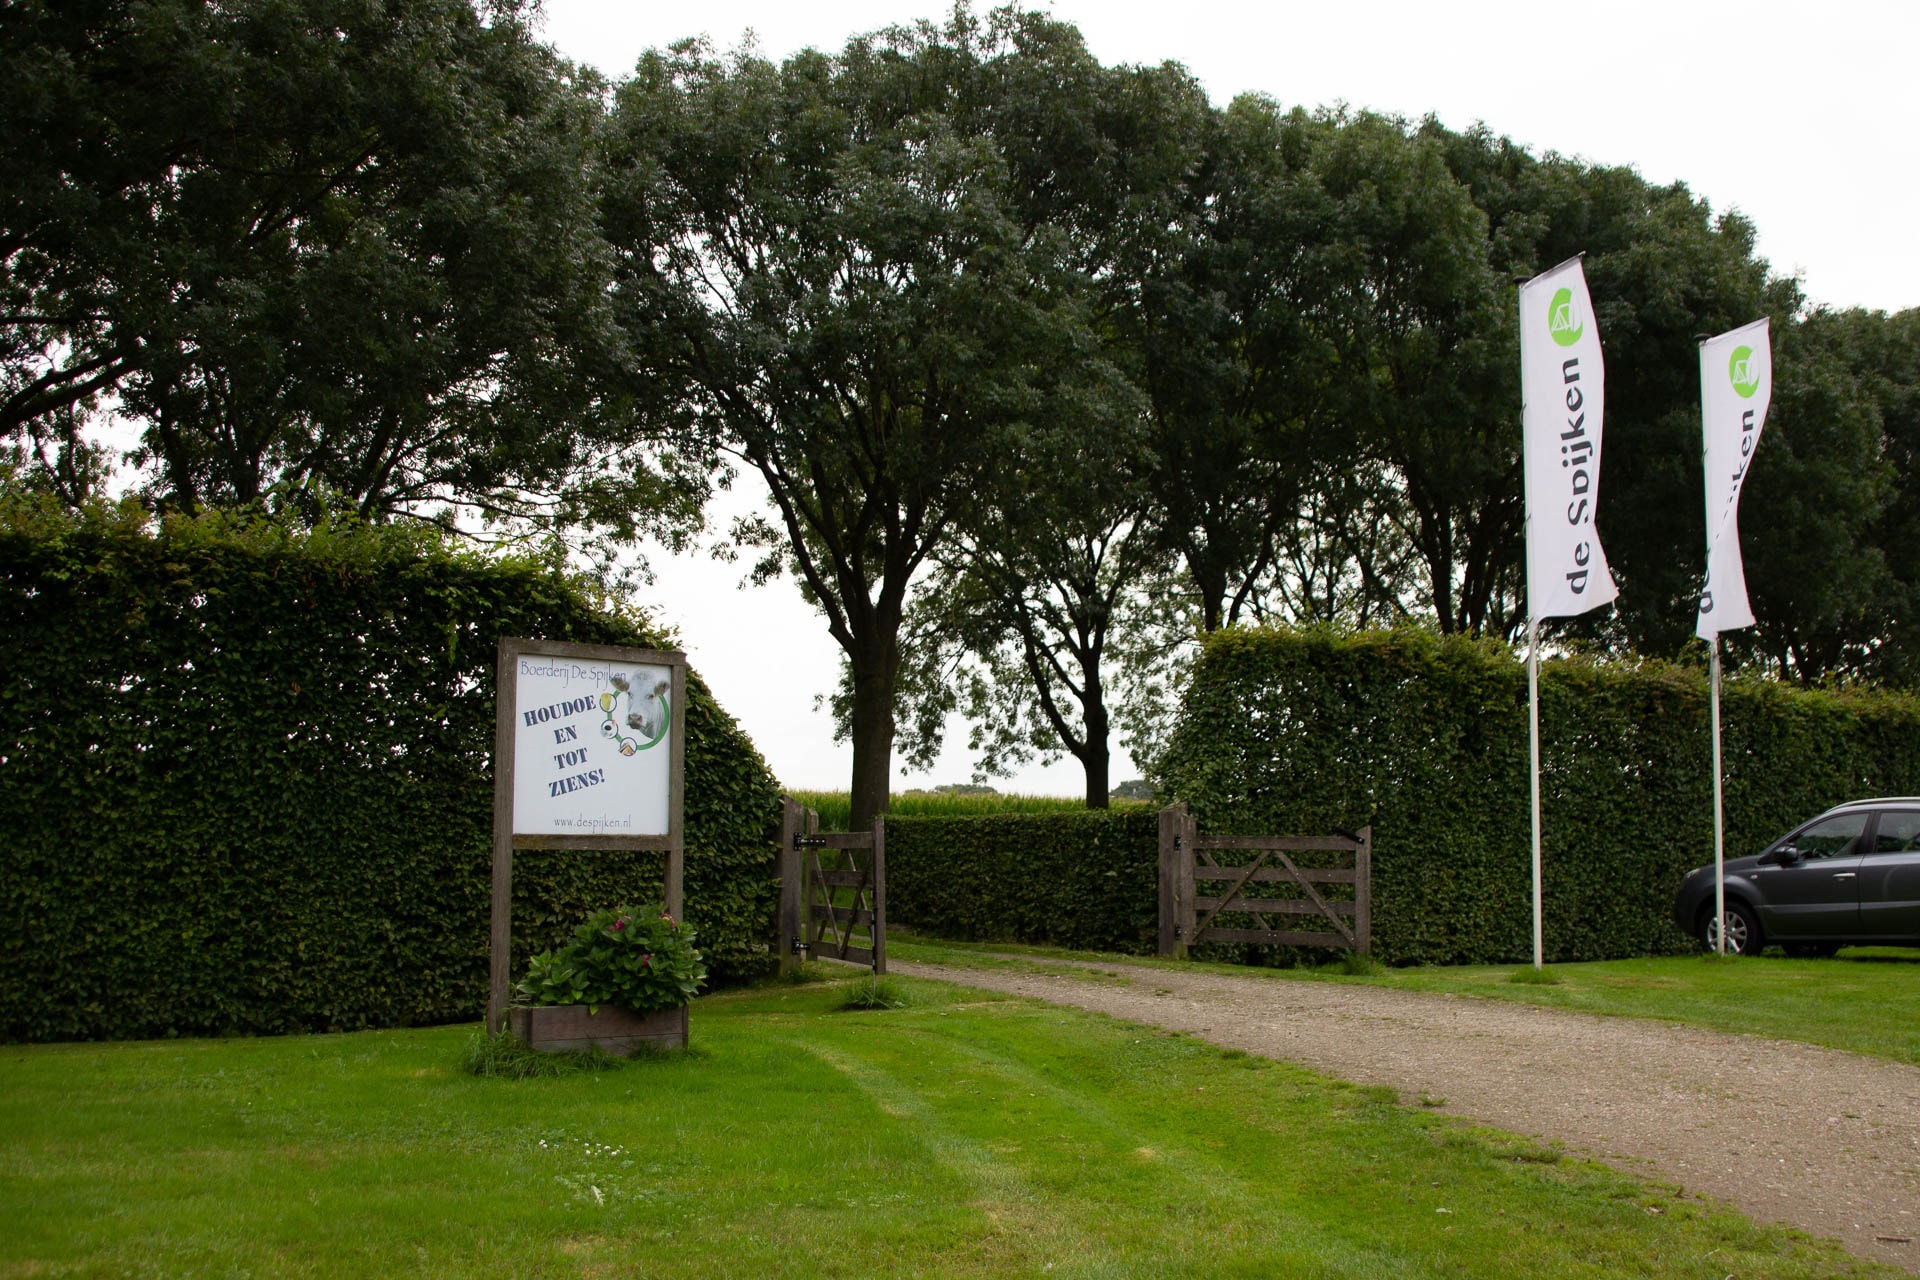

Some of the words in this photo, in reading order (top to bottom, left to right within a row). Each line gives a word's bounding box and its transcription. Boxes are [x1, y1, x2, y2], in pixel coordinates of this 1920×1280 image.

[1560, 357, 1593, 526] Spijken
[1566, 541, 1590, 595] de
[521, 659, 569, 688] Boerderij
[572, 665, 587, 679] De
[590, 664, 627, 690] Spijken
[523, 695, 596, 727] HOUDOE
[554, 725, 577, 744] EN
[554, 747, 587, 769] TOT
[549, 768, 605, 797] ZIENS!
[554, 813, 631, 832] www.despijken.nl
